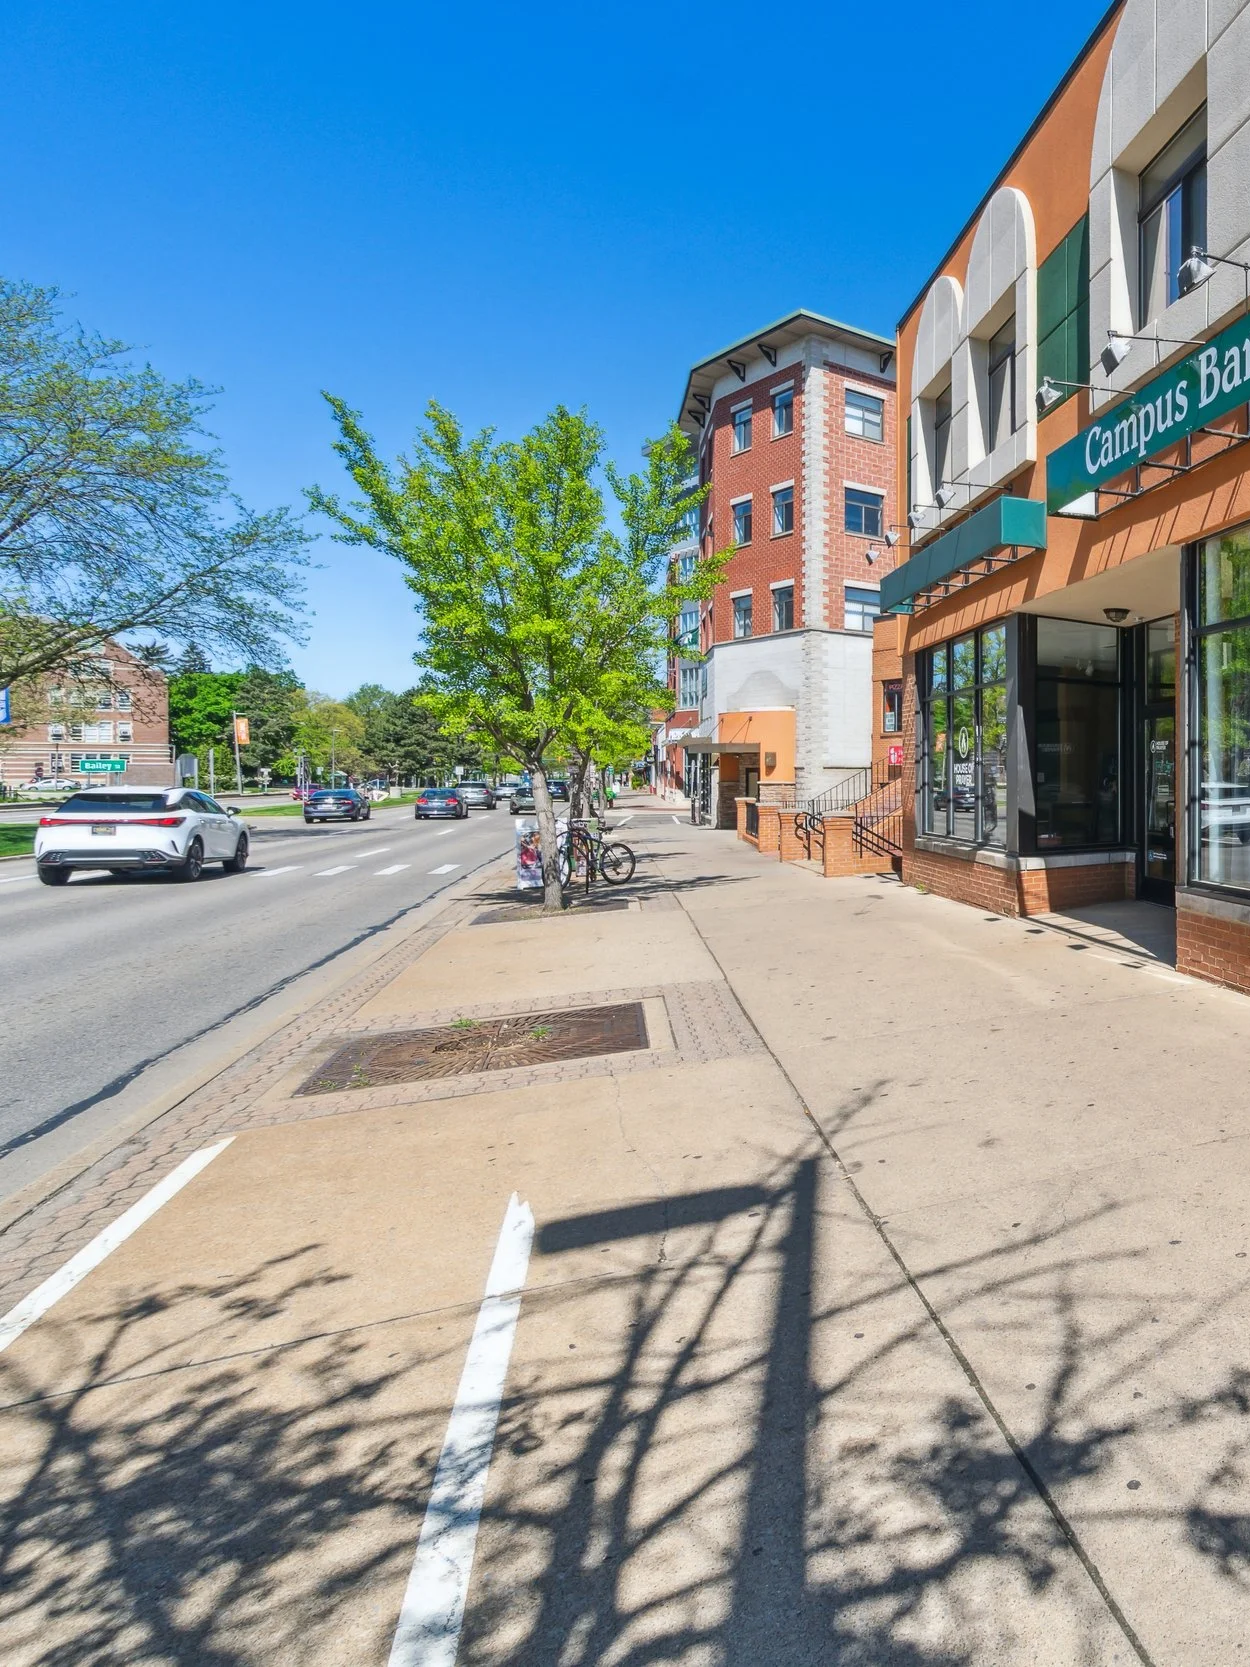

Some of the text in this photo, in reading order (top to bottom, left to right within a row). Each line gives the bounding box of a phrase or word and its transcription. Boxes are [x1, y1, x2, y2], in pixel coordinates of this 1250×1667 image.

[1085, 380, 1188, 474] Campus
[84, 762, 112, 771] Bailey
[953, 763, 968, 774] HOUSE
